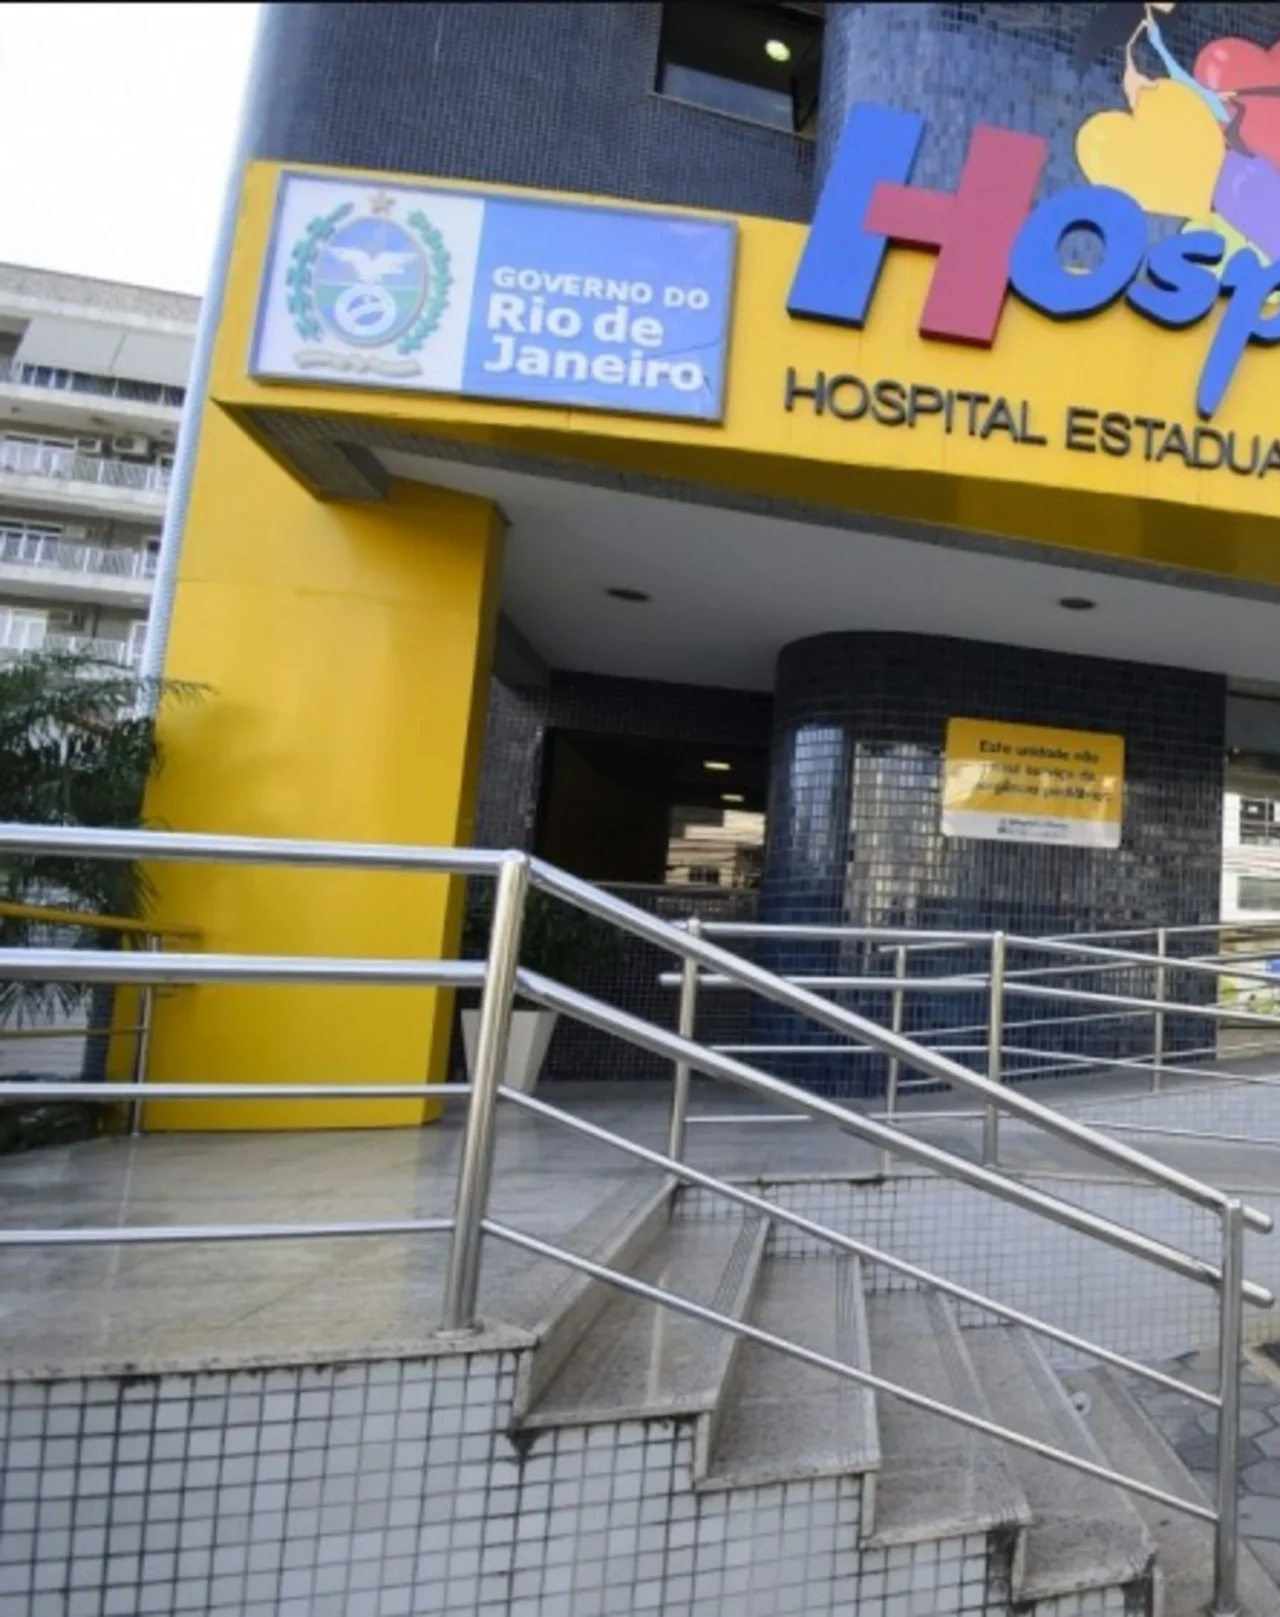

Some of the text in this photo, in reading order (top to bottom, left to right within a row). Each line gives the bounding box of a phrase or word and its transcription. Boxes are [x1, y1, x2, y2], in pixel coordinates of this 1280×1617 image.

[492, 266, 710, 310] GOVERNO DO
[486, 294, 664, 347] Rio de
[483, 335, 703, 392] Janeiro
[784, 367, 1047, 446] HOSPITAL
